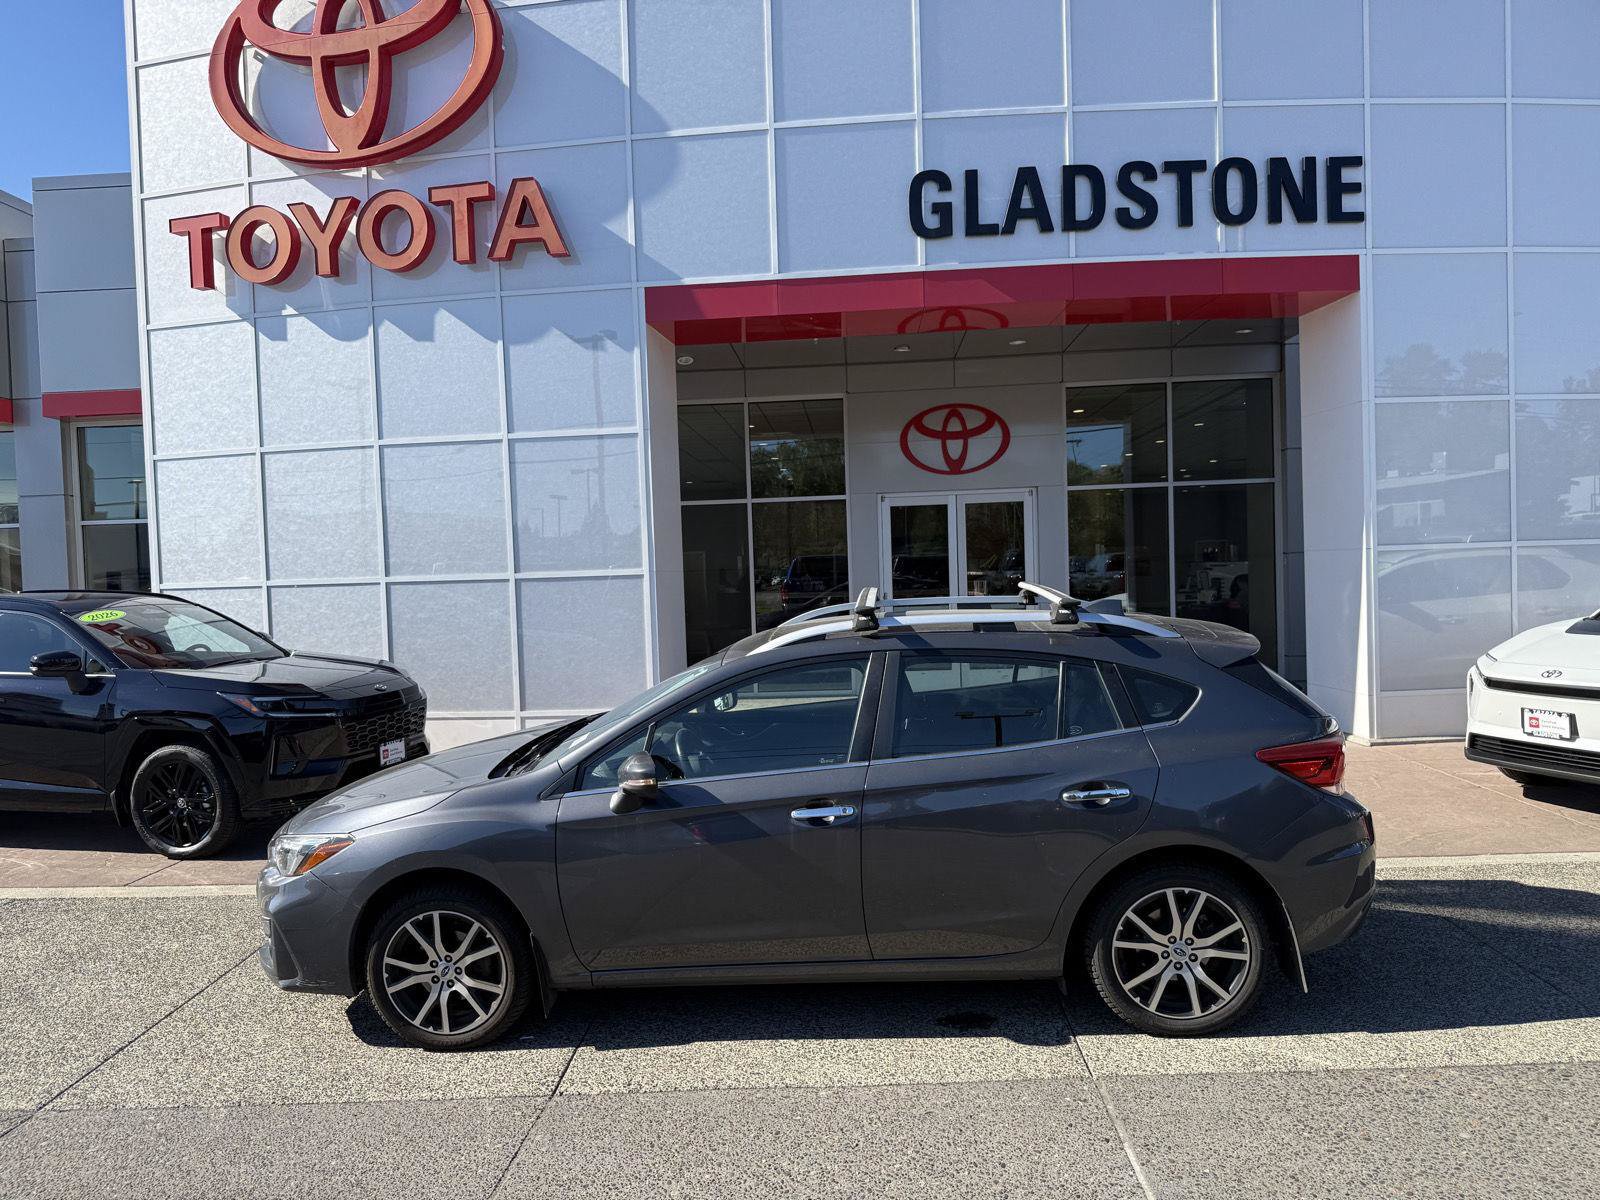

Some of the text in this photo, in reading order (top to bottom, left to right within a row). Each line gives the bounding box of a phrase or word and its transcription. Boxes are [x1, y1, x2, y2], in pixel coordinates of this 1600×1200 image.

[169, 176, 571, 291] TOYOTA
[908, 155, 1364, 239] GLADSTONE
[87, 611, 119, 621] 2026
